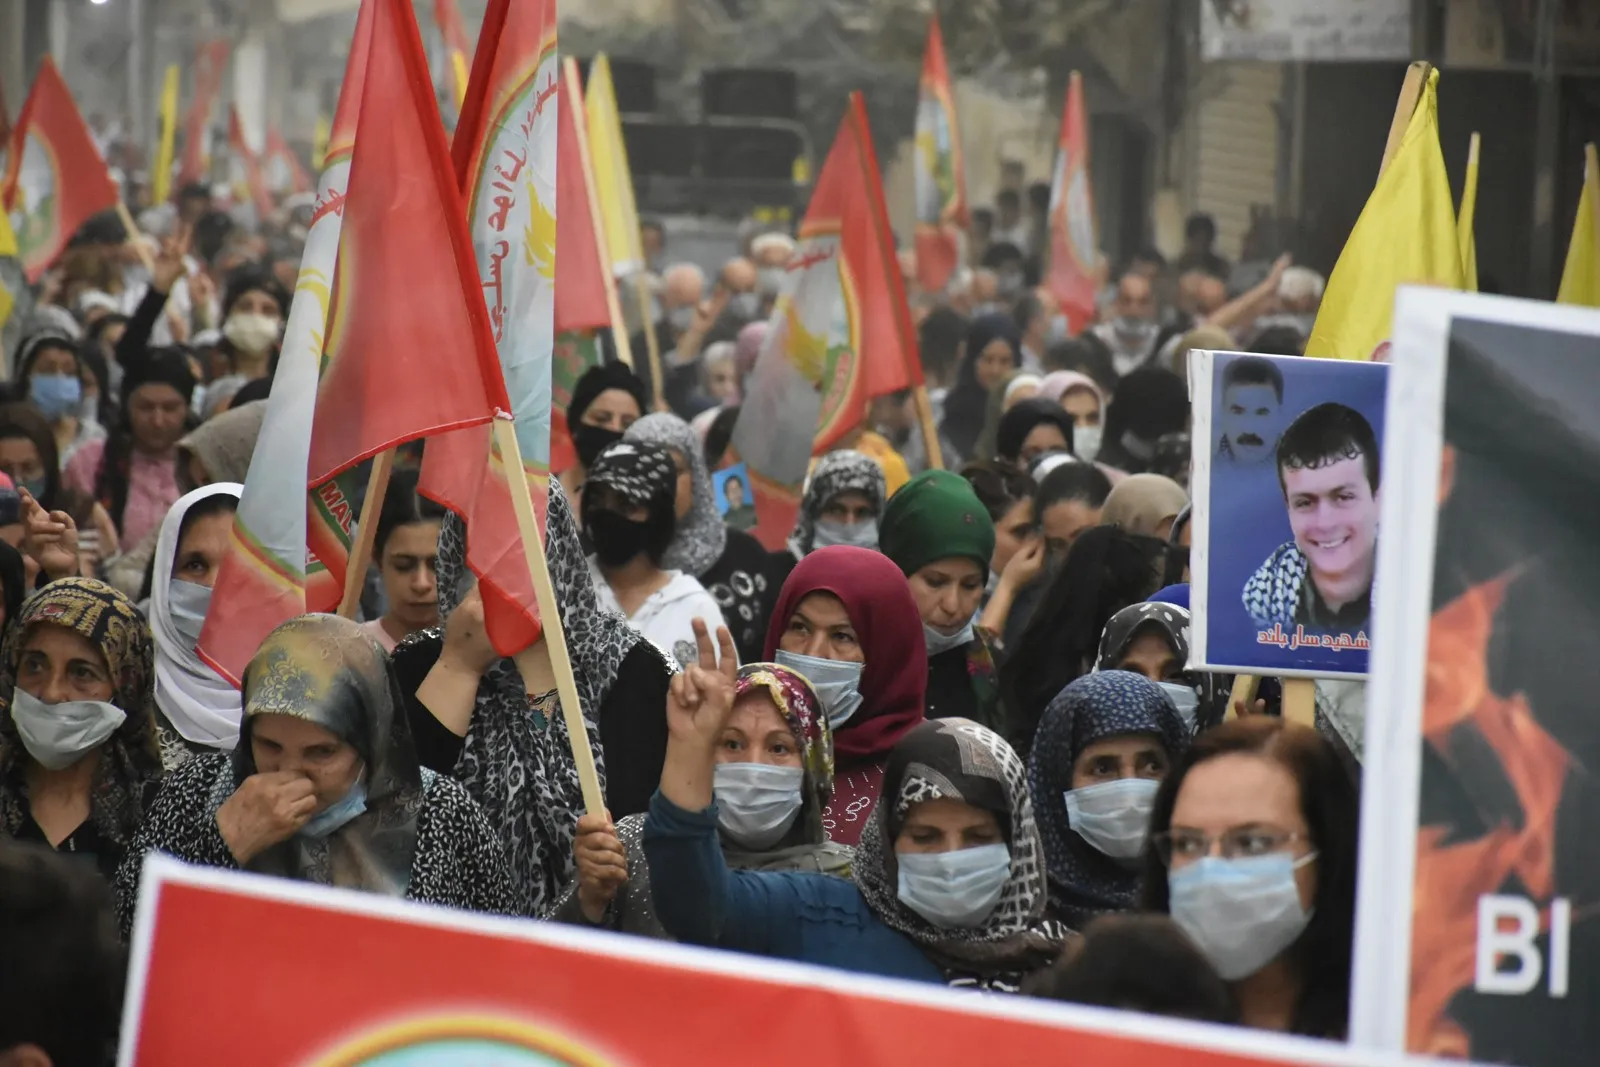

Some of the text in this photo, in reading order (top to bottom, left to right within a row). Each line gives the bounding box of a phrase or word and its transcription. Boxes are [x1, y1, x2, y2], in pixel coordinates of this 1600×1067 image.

[1257, 623, 1370, 651] شهيد سار بلند
[1476, 895, 1569, 997] BI
